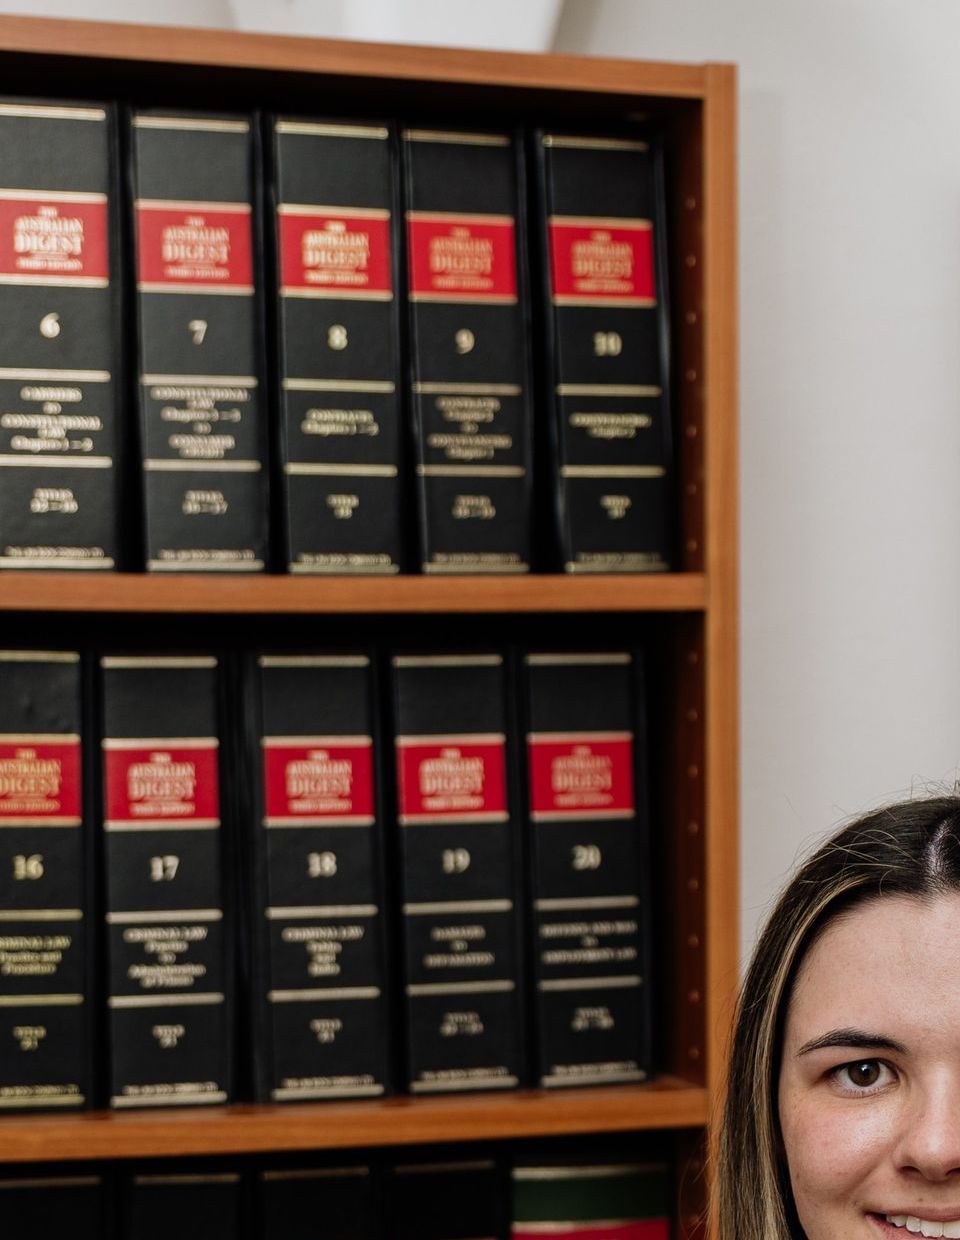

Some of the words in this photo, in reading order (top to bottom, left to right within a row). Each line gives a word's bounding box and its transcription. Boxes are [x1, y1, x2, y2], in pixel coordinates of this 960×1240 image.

[14, 217, 83, 233] AUSTRALIAN
[14, 233, 83, 253] DIGEST
[162, 242, 230, 263] DIGEST
[303, 248, 369, 269] DIGEST
[430, 253, 492, 274] DIGEST
[572, 258, 633, 278] DIGEST
[40, 312, 60, 338] 6
[188, 319, 207, 344] 7
[328, 324, 348, 350] 8
[455, 328, 474, 354] 9
[594, 331, 622, 357] 10
[128, 763, 195, 778] AUSTRALIAN
[552, 770, 612, 790] DIGEST
[128, 778, 196, 801] DIGEST
[286, 777, 353, 798] DIGEST
[420, 774, 484, 796] DIGEST
[14, 854, 44, 880] 16
[151, 855, 179, 881] 17
[308, 851, 337, 877] 18
[442, 848, 470, 874] 19
[572, 845, 601, 871] 20
